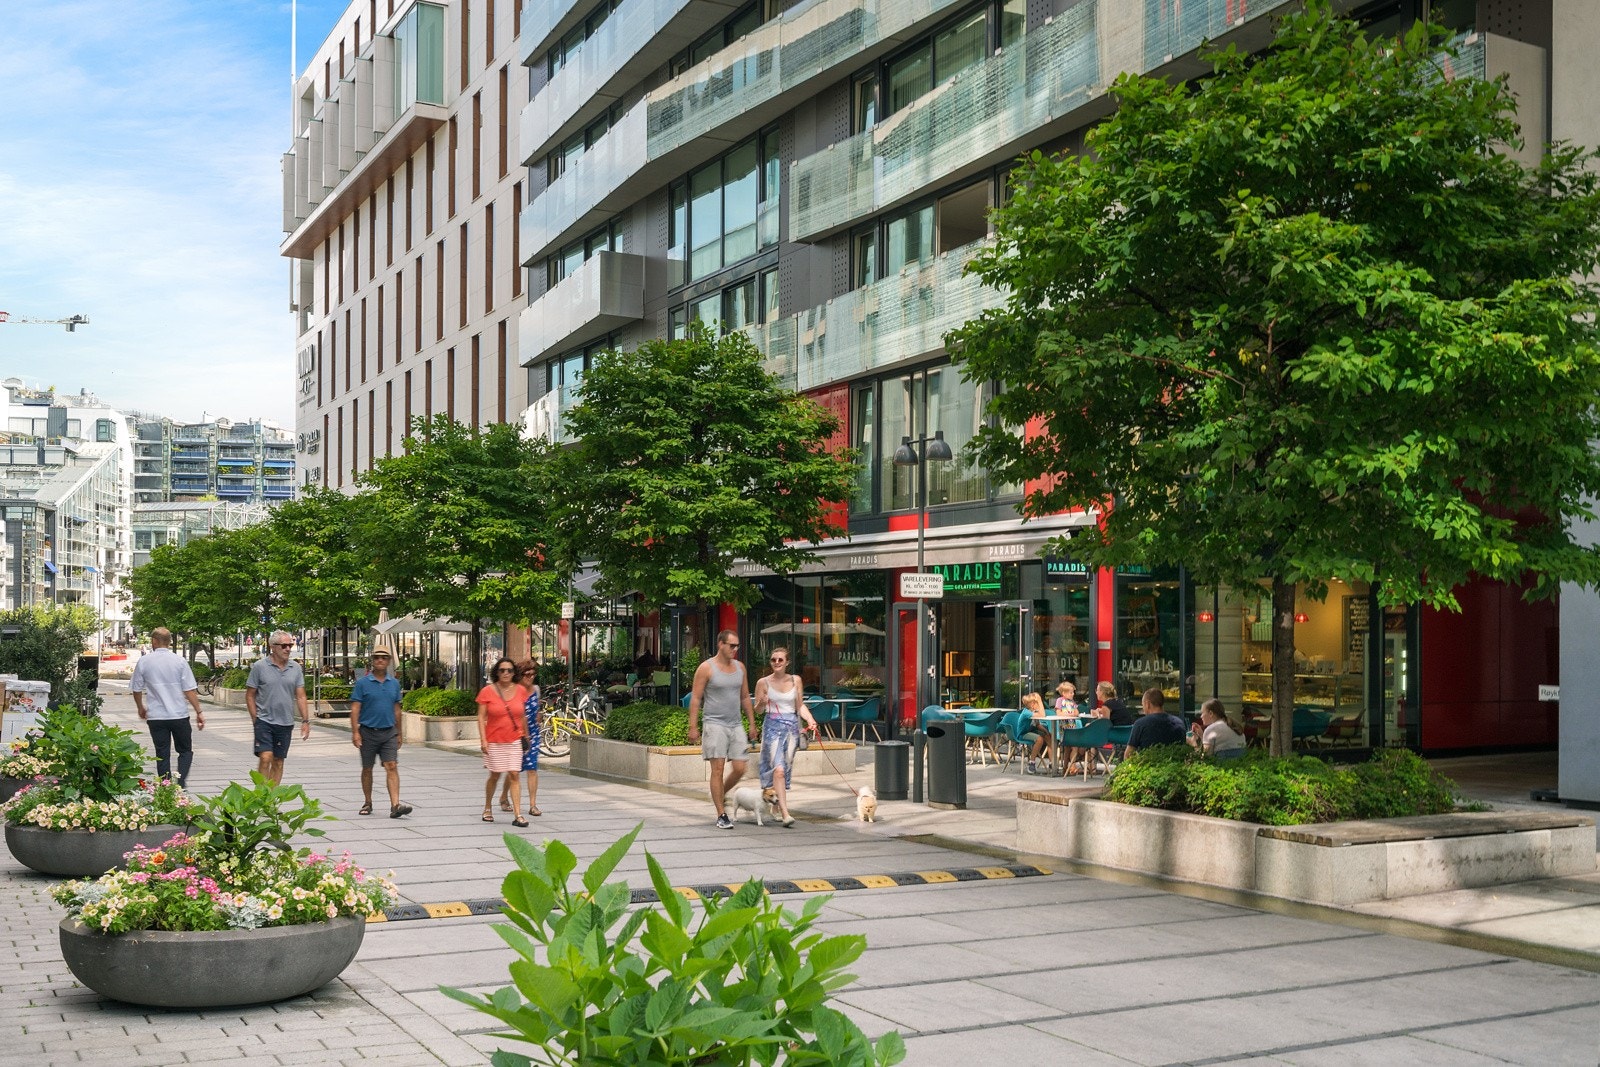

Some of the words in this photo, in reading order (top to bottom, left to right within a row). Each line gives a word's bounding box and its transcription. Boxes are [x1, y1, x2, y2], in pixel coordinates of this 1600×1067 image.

[989, 544, 1025, 556] PARADIS
[850, 555, 878, 565] PARADIS
[934, 562, 1001, 581] PARADIS
[1047, 563, 1086, 572] PARADIS
[838, 651, 869, 661] PARADIS
[1122, 658, 1174, 672] PARADIS
